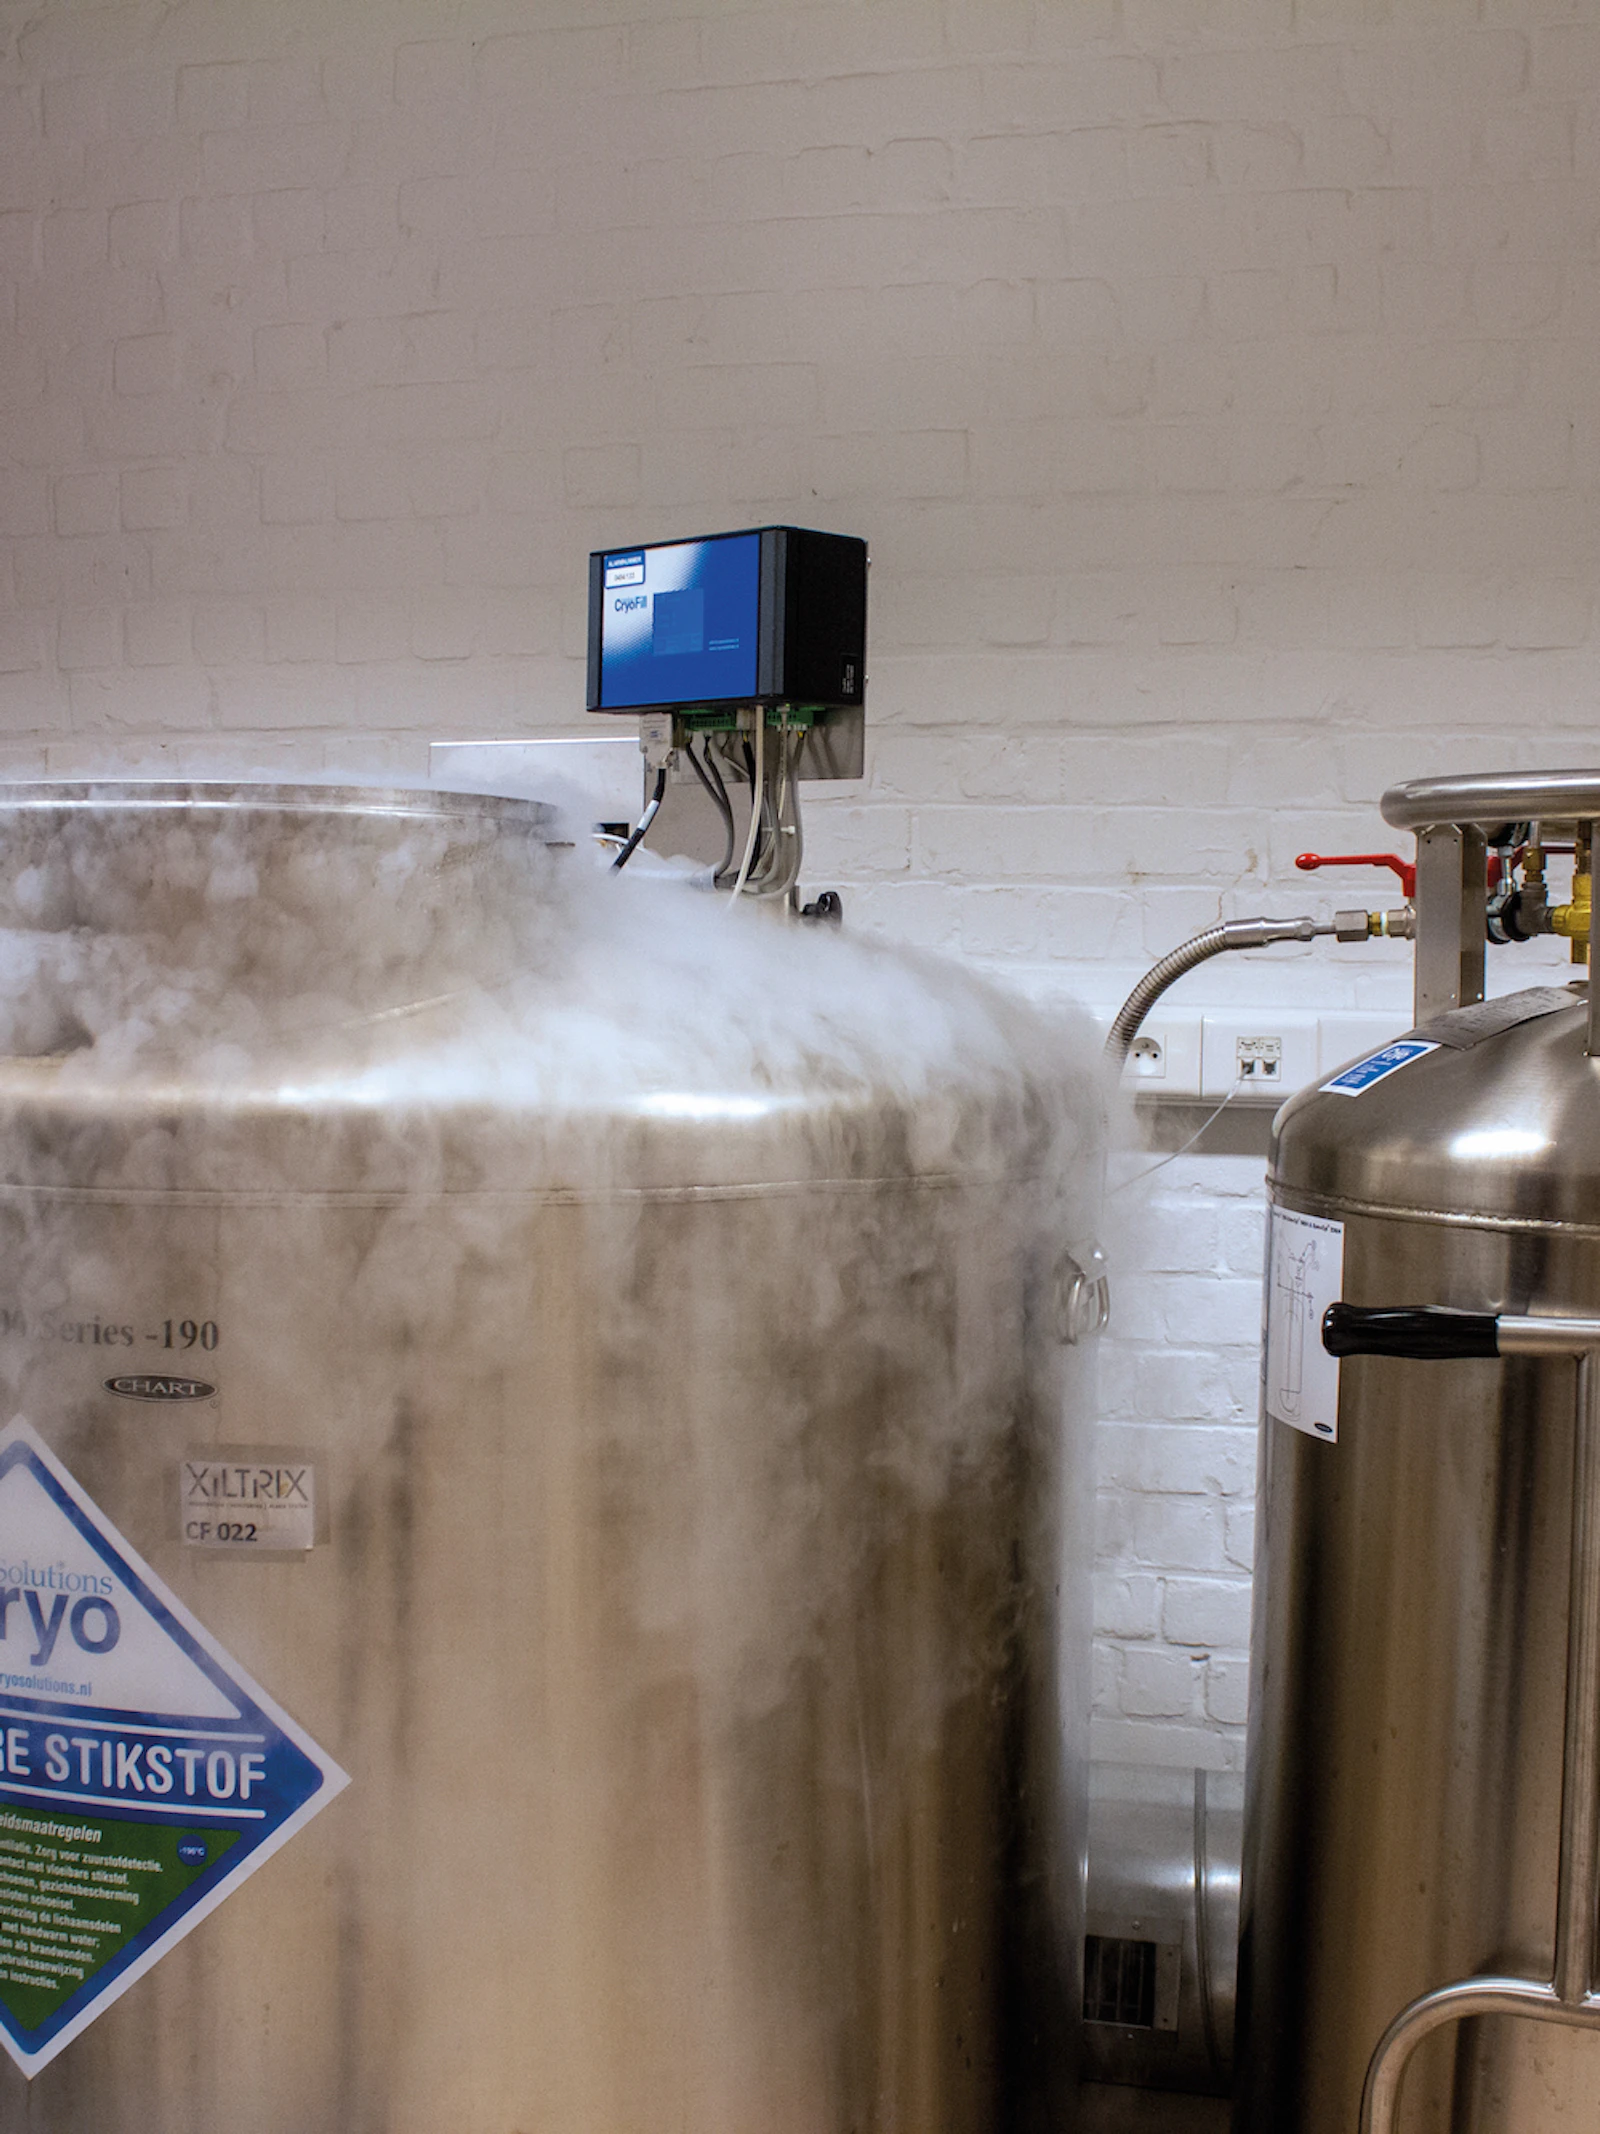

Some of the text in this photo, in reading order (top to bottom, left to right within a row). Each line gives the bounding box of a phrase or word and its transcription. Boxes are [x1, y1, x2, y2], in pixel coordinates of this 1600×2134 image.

[145, 1319, 220, 1351] -190
[113, 1379, 203, 1396] CHART
[186, 1521, 257, 1542] CF 022
[0, 1586, 121, 1666] ryo
[0, 1728, 266, 1800] E STIKSTOF
[34, 1843, 58, 1861] Zorg
[59, 1850, 81, 1862] voor
